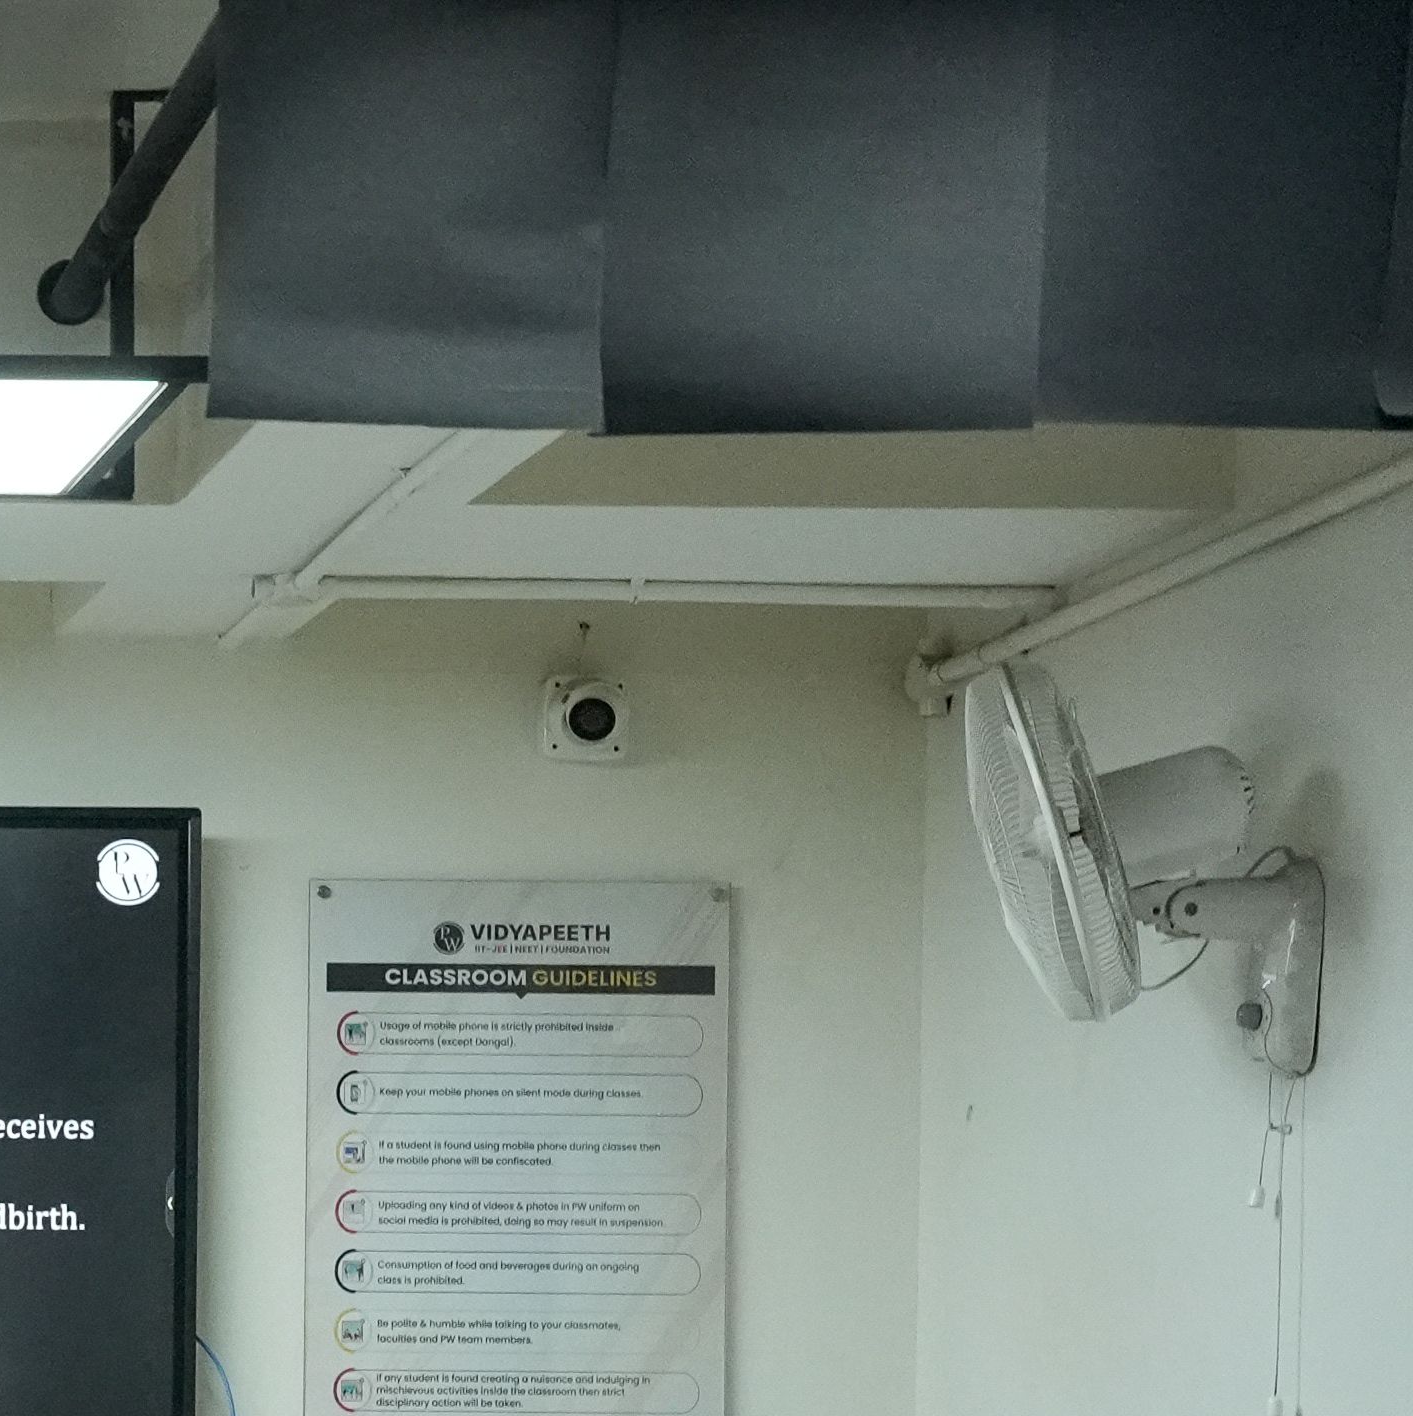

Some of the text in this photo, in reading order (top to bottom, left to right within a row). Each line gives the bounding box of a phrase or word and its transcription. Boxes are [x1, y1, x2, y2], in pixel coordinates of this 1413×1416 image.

[470, 924, 610, 941] VIDYAPEETH
[546, 944, 610, 954] FOUNDATION
[385, 968, 656, 986] CLASSROOM GUIDELINES
[380, 1021, 410, 1032] Usage
[424, 1020, 456, 1032] mobile
[459, 1022, 488, 1033] phone
[501, 1021, 532, 1033] strictly
[535, 1022, 583, 1033] prohibited
[586, 1022, 614, 1032] inside
[380, 1037, 434, 1046] classrooms
[438, 1035, 472, 1048] (except
[380, 1088, 403, 1098] Keep
[406, 1089, 426, 1098] your
[429, 1088, 461, 1096] mobile
[464, 1088, 499, 1099] phones
[516, 1088, 540, 1097] silent
[544, 1089, 571, 1098] mode
[573, 1088, 604, 1101] during
[396, 1141, 432, 1150] student
[444, 1140, 471, 1150] found
[474, 1141, 499, 1153] using
[502, 1141, 534, 1150] mobile
[537, 1141, 567, 1153] phone
[570, 1141, 600, 1153] during
[602, 1142, 637, 1151] classes
[379, 1156, 394, 1164] the
[397, 1156, 429, 1165] mobile
[432, 1156, 461, 1167] phone
[464, 1157, 479, 1165] will
[378, 1260, 442, 1271] Consumption
[456, 1260, 476, 1270] food
[479, 1261, 498, 1270] and
[501, 1260, 550, 1273] beverages
[553, 1262, 583, 1273] during
[600, 1261, 639, 1274] ongoing
[378, 1276, 401, 1284] class
[391, 1319, 417, 1331] polite
[430, 1319, 465, 1329] humble
[468, 1320, 492, 1328] while
[495, 1320, 527, 1332] talking
[541, 1322, 562, 1332] your
[377, 1334, 417, 1344] faculties
[420, 1334, 438, 1343] and
[458, 1335, 482, 1344] team
